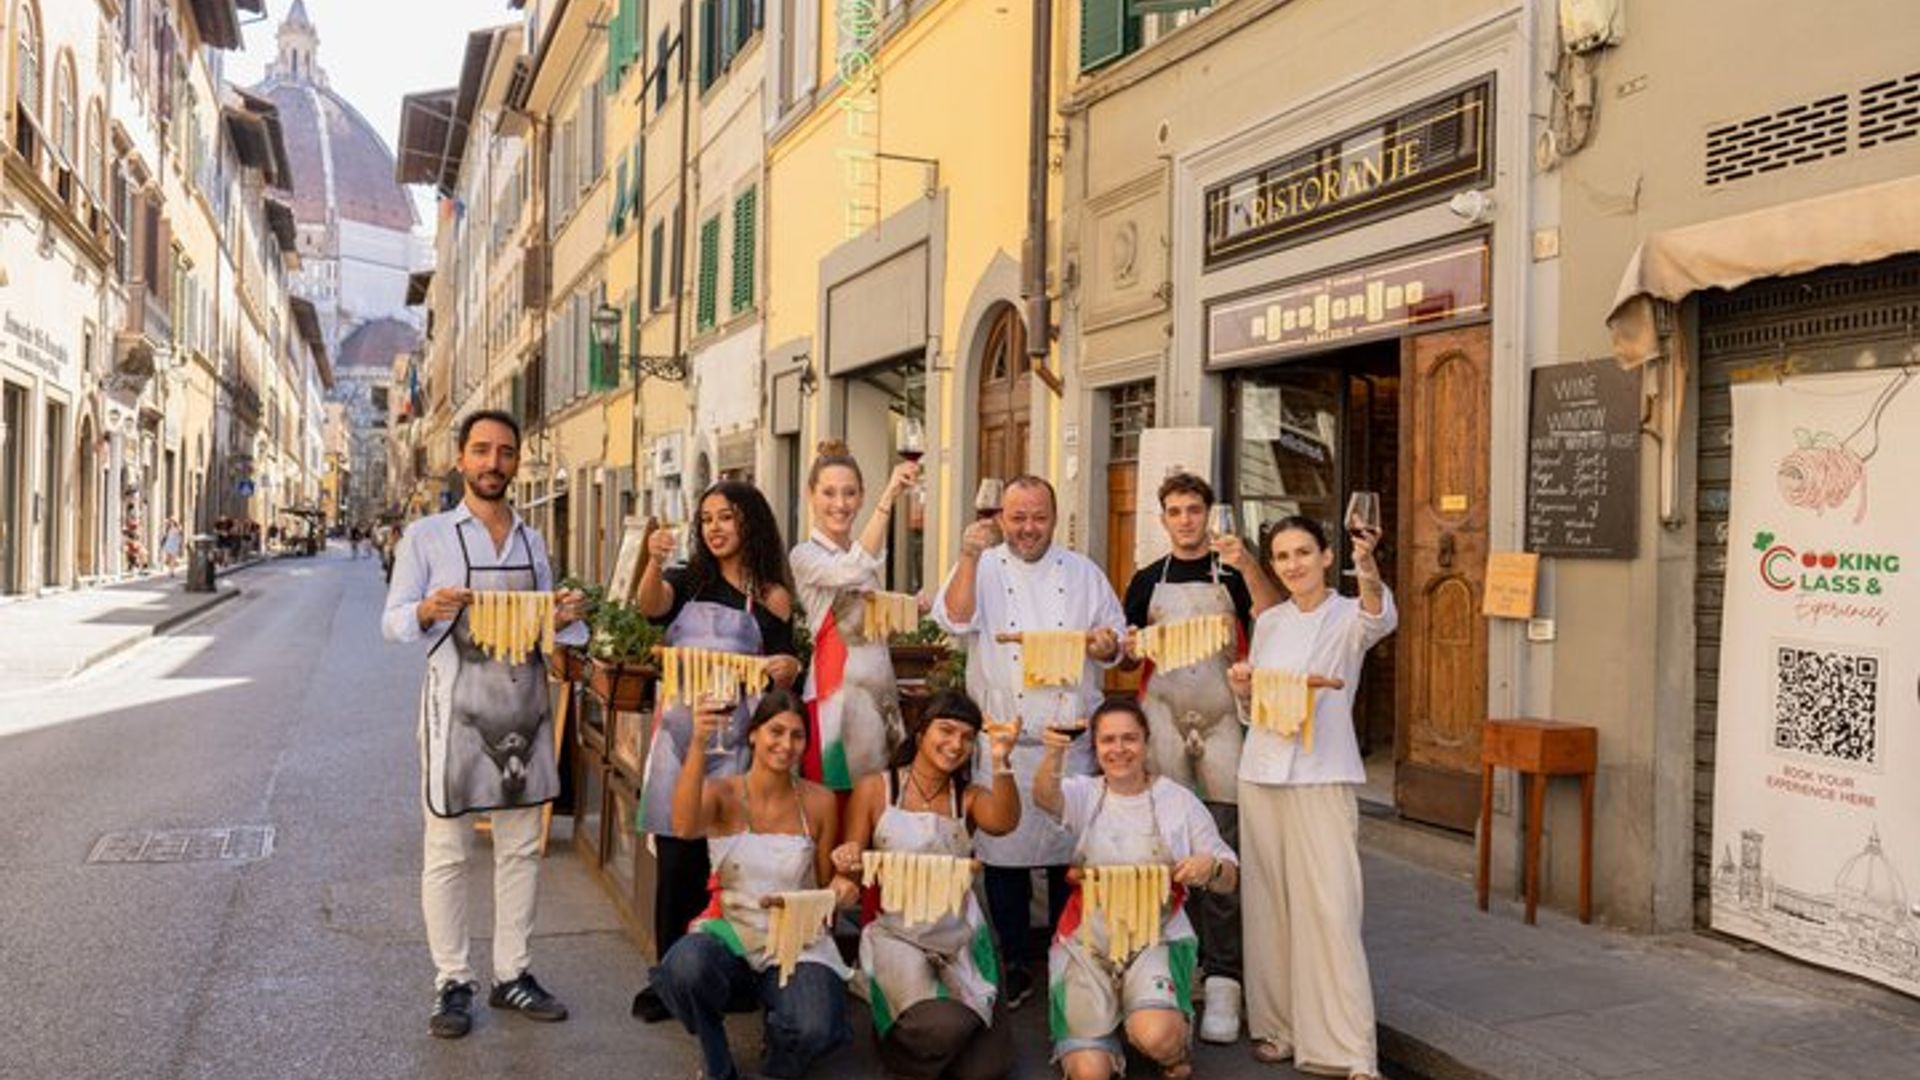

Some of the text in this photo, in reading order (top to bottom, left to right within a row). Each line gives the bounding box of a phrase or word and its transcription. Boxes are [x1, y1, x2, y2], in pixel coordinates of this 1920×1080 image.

[1250, 139, 1421, 229] RISTORANTE
[1552, 374, 1598, 400] WINE
[1866, 577, 1882, 595] &
[1783, 765, 1855, 788] BOOK YOUR
[1765, 775, 1876, 807] EXPERIENCE HERE
